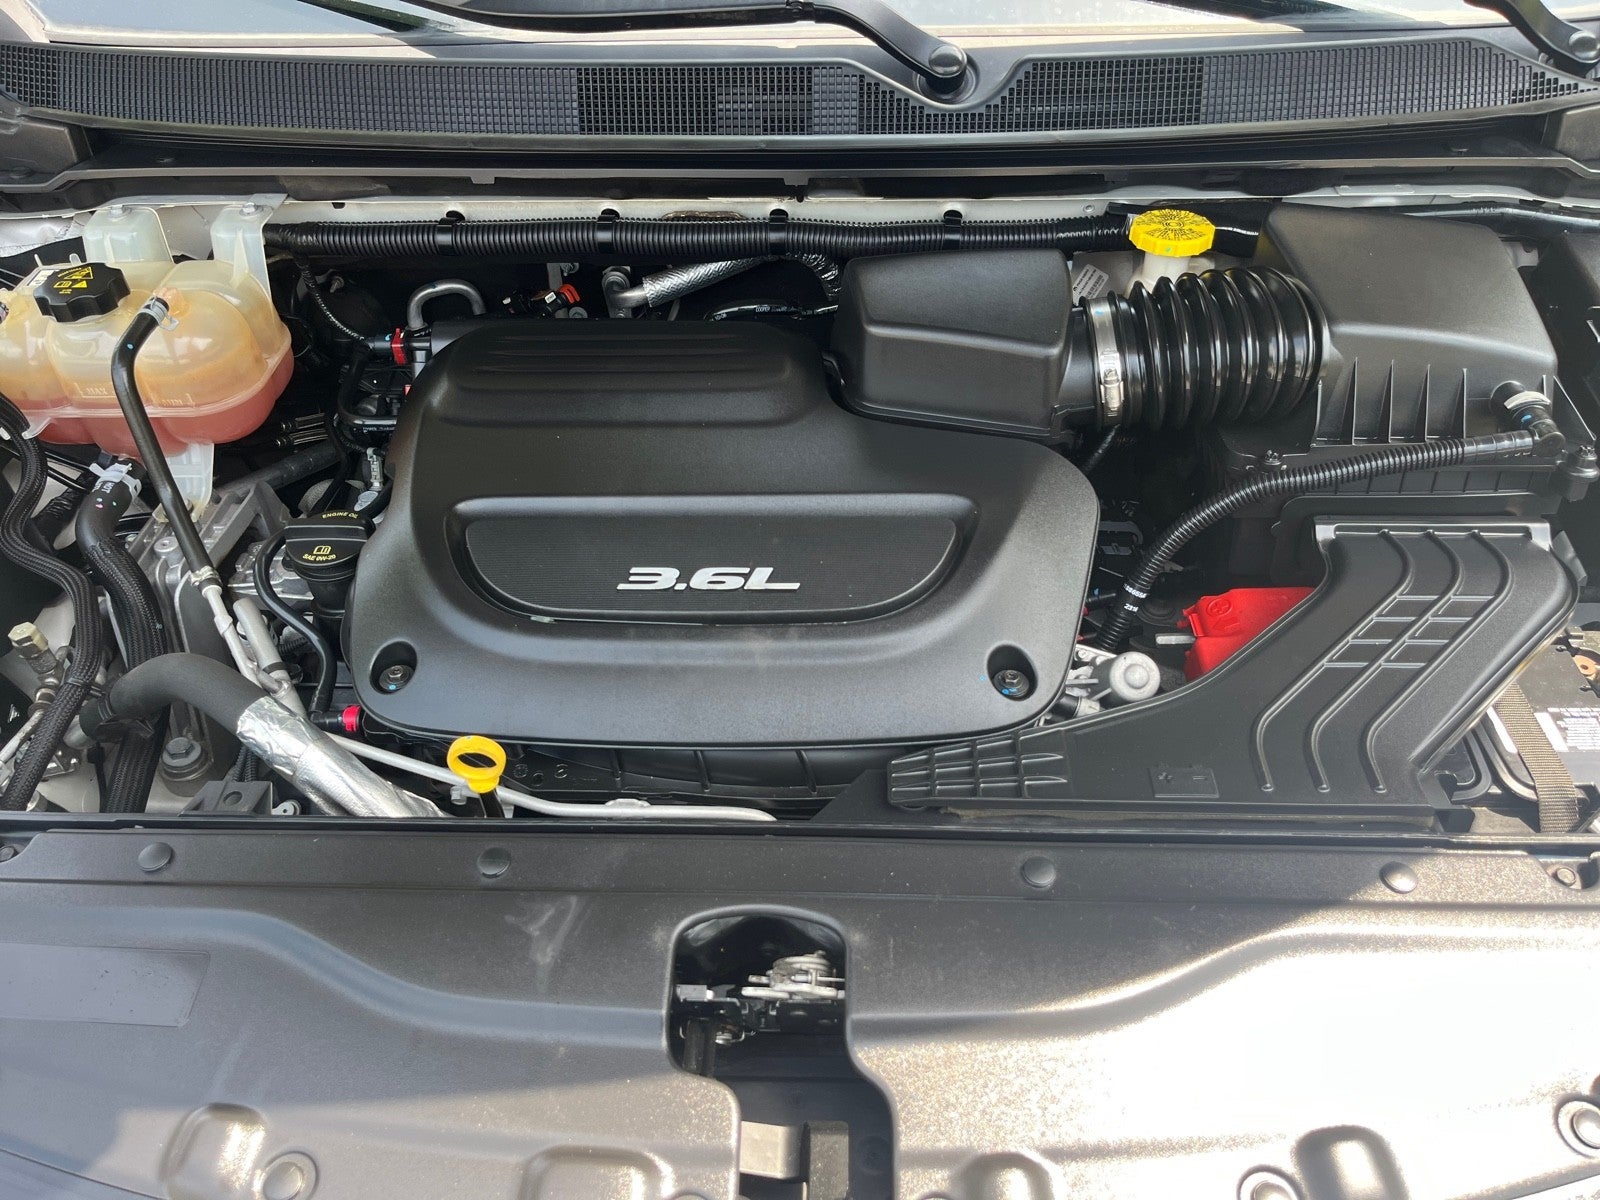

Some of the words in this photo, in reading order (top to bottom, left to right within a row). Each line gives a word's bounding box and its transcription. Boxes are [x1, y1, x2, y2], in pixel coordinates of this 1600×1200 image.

[322, 511, 348, 519] ENGINE
[302, 553, 315, 561] SAE
[616, 567, 801, 590] 3.6L
